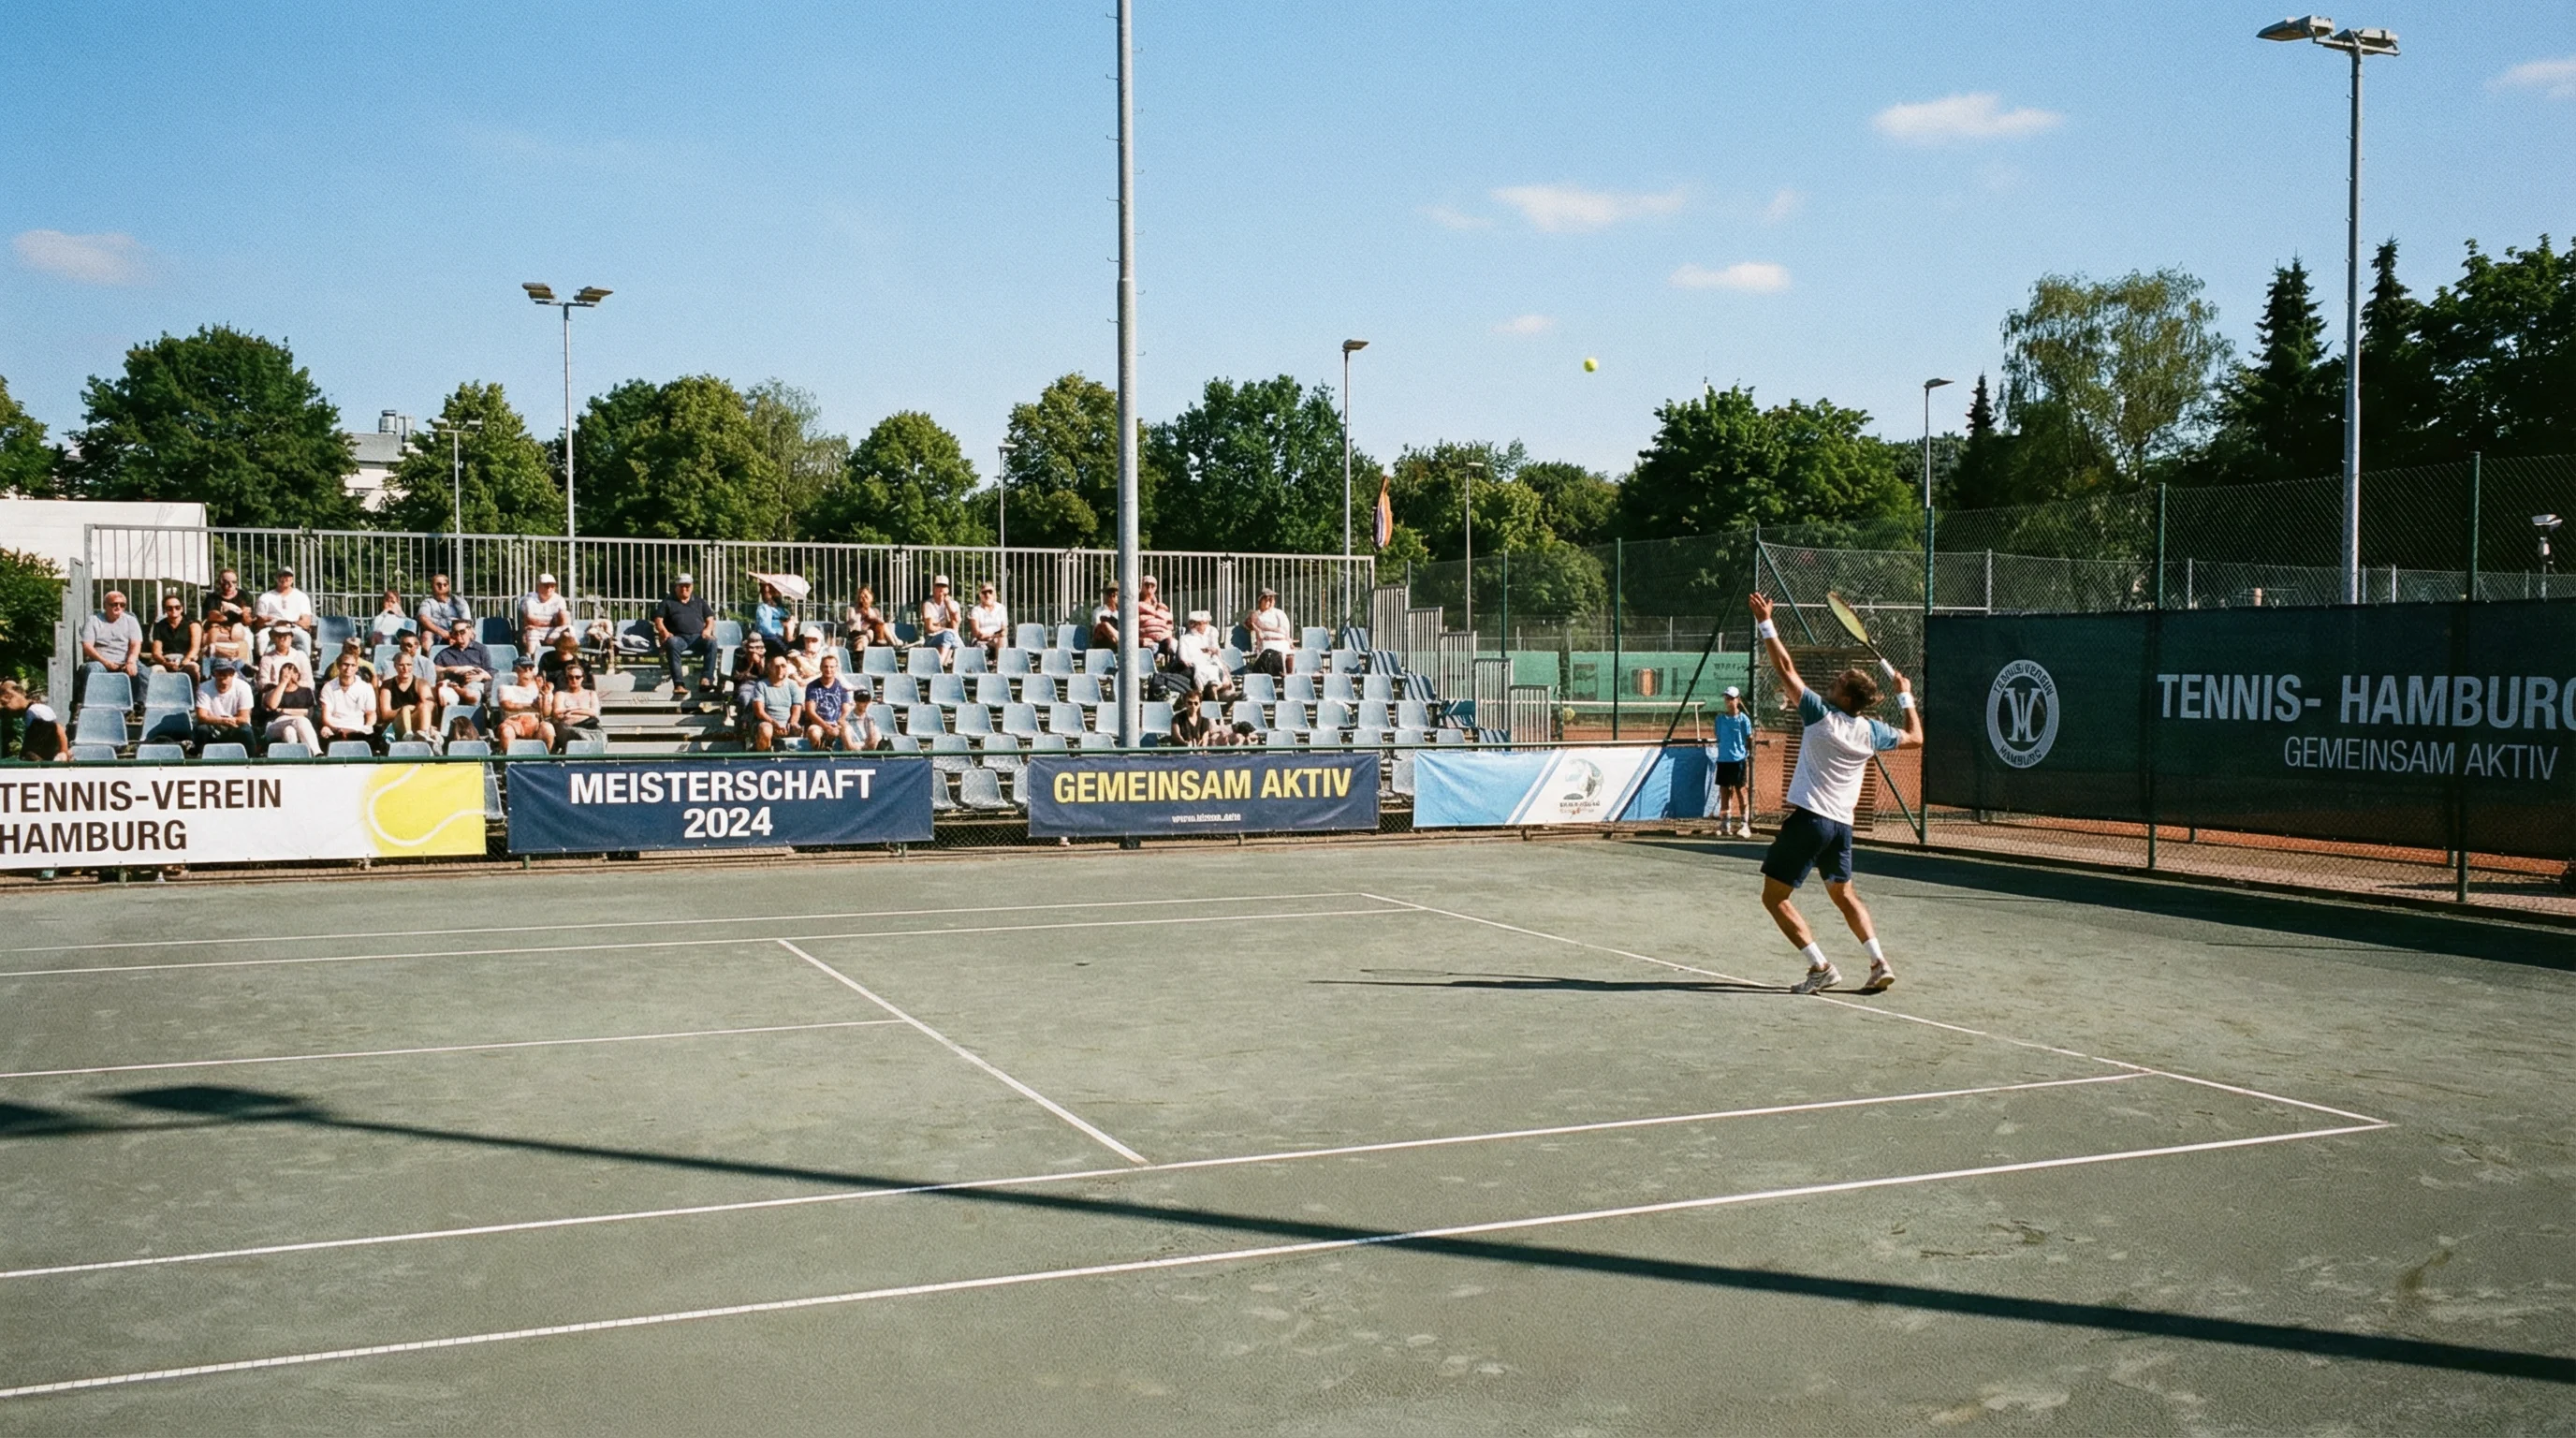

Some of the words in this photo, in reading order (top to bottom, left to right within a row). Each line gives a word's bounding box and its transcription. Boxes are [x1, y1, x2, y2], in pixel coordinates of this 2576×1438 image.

[2157, 674, 2321, 722] TENNIS-
[2284, 736, 2455, 775] GEMEINSAM
[2464, 742, 2558, 780] AKTIV
[0, 779, 281, 814] TENNIS-VEREIN
[570, 769, 876, 804] MEISTERSCHAFT
[1053, 769, 1251, 803] GEMEINSAM
[1260, 768, 1353, 799] AKTIV
[0, 819, 187, 855] HAMBURG
[683, 806, 774, 839] 2024
